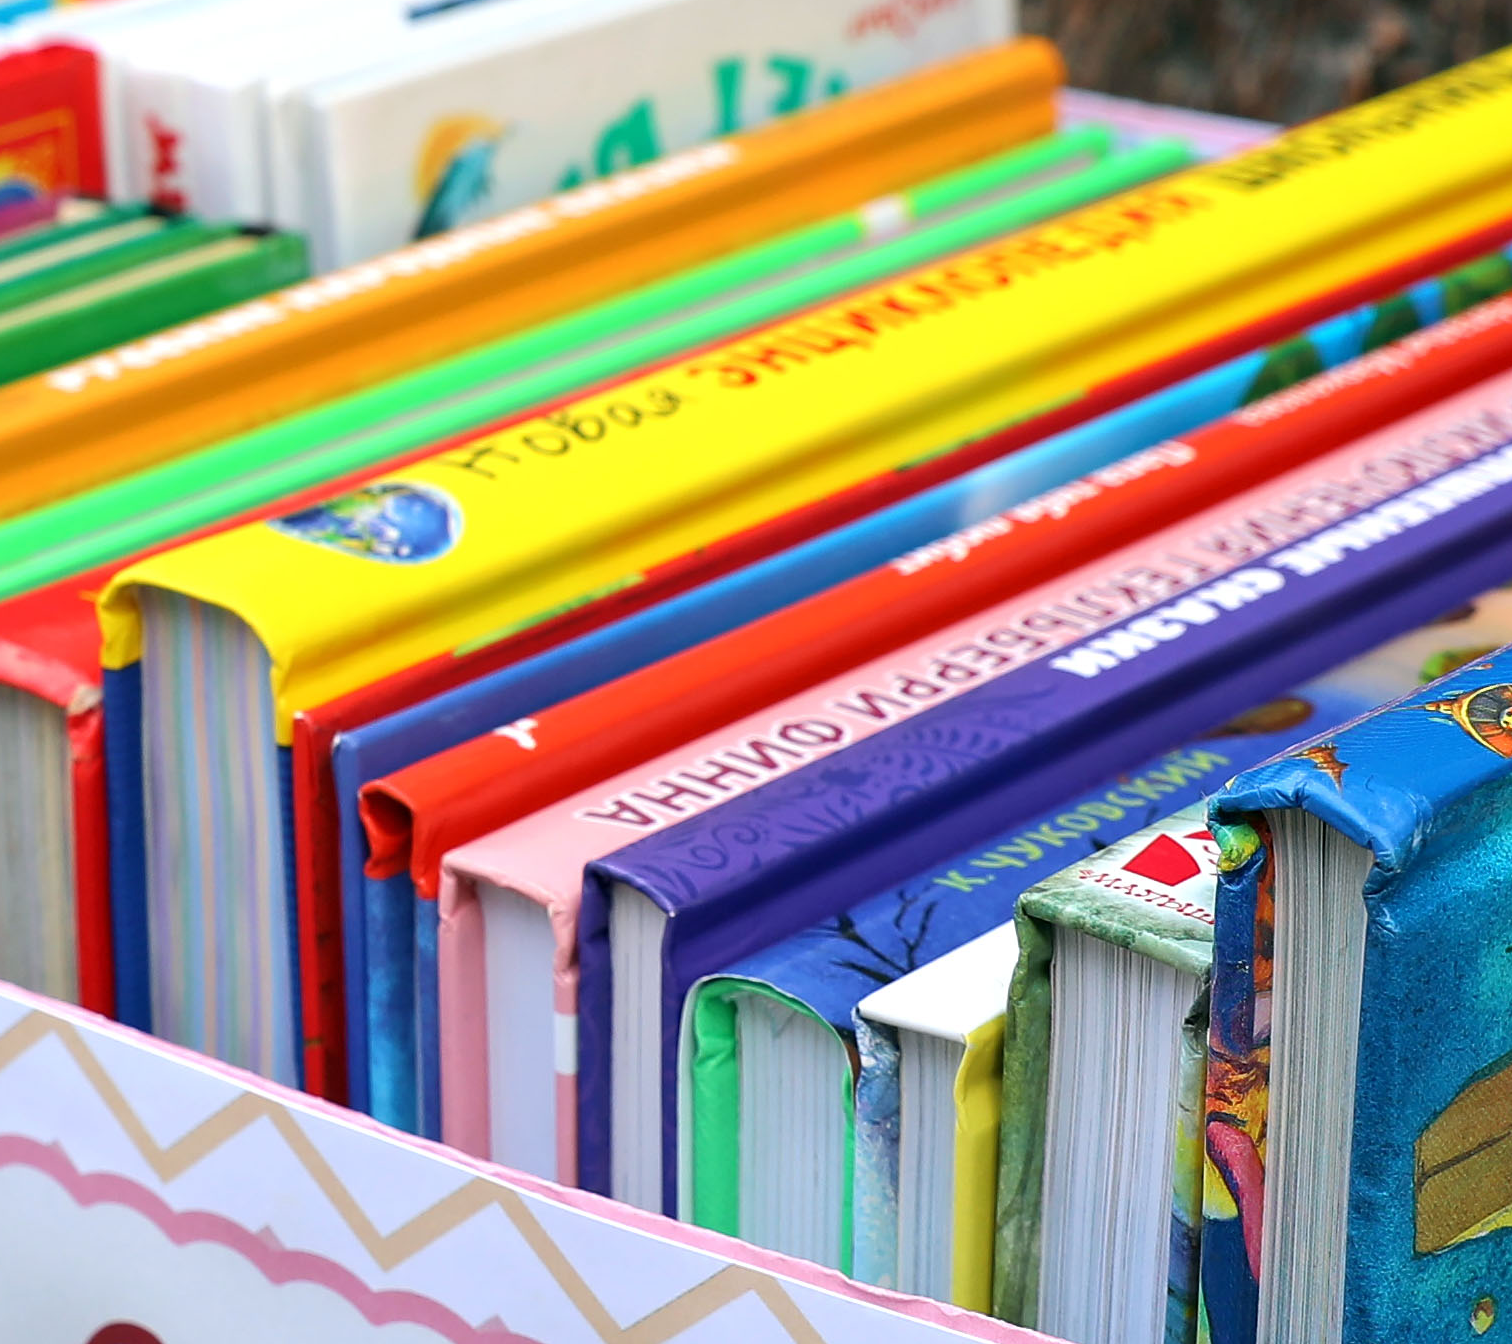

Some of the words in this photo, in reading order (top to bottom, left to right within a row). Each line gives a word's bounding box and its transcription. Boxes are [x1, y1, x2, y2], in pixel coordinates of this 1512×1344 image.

[443, 385, 681, 480] Новая
[836, 550, 1208, 724] ГЕКЛЬБЕРРИ
[1048, 565, 1287, 678] СКАЗКИ
[585, 715, 846, 829] ФИННА
